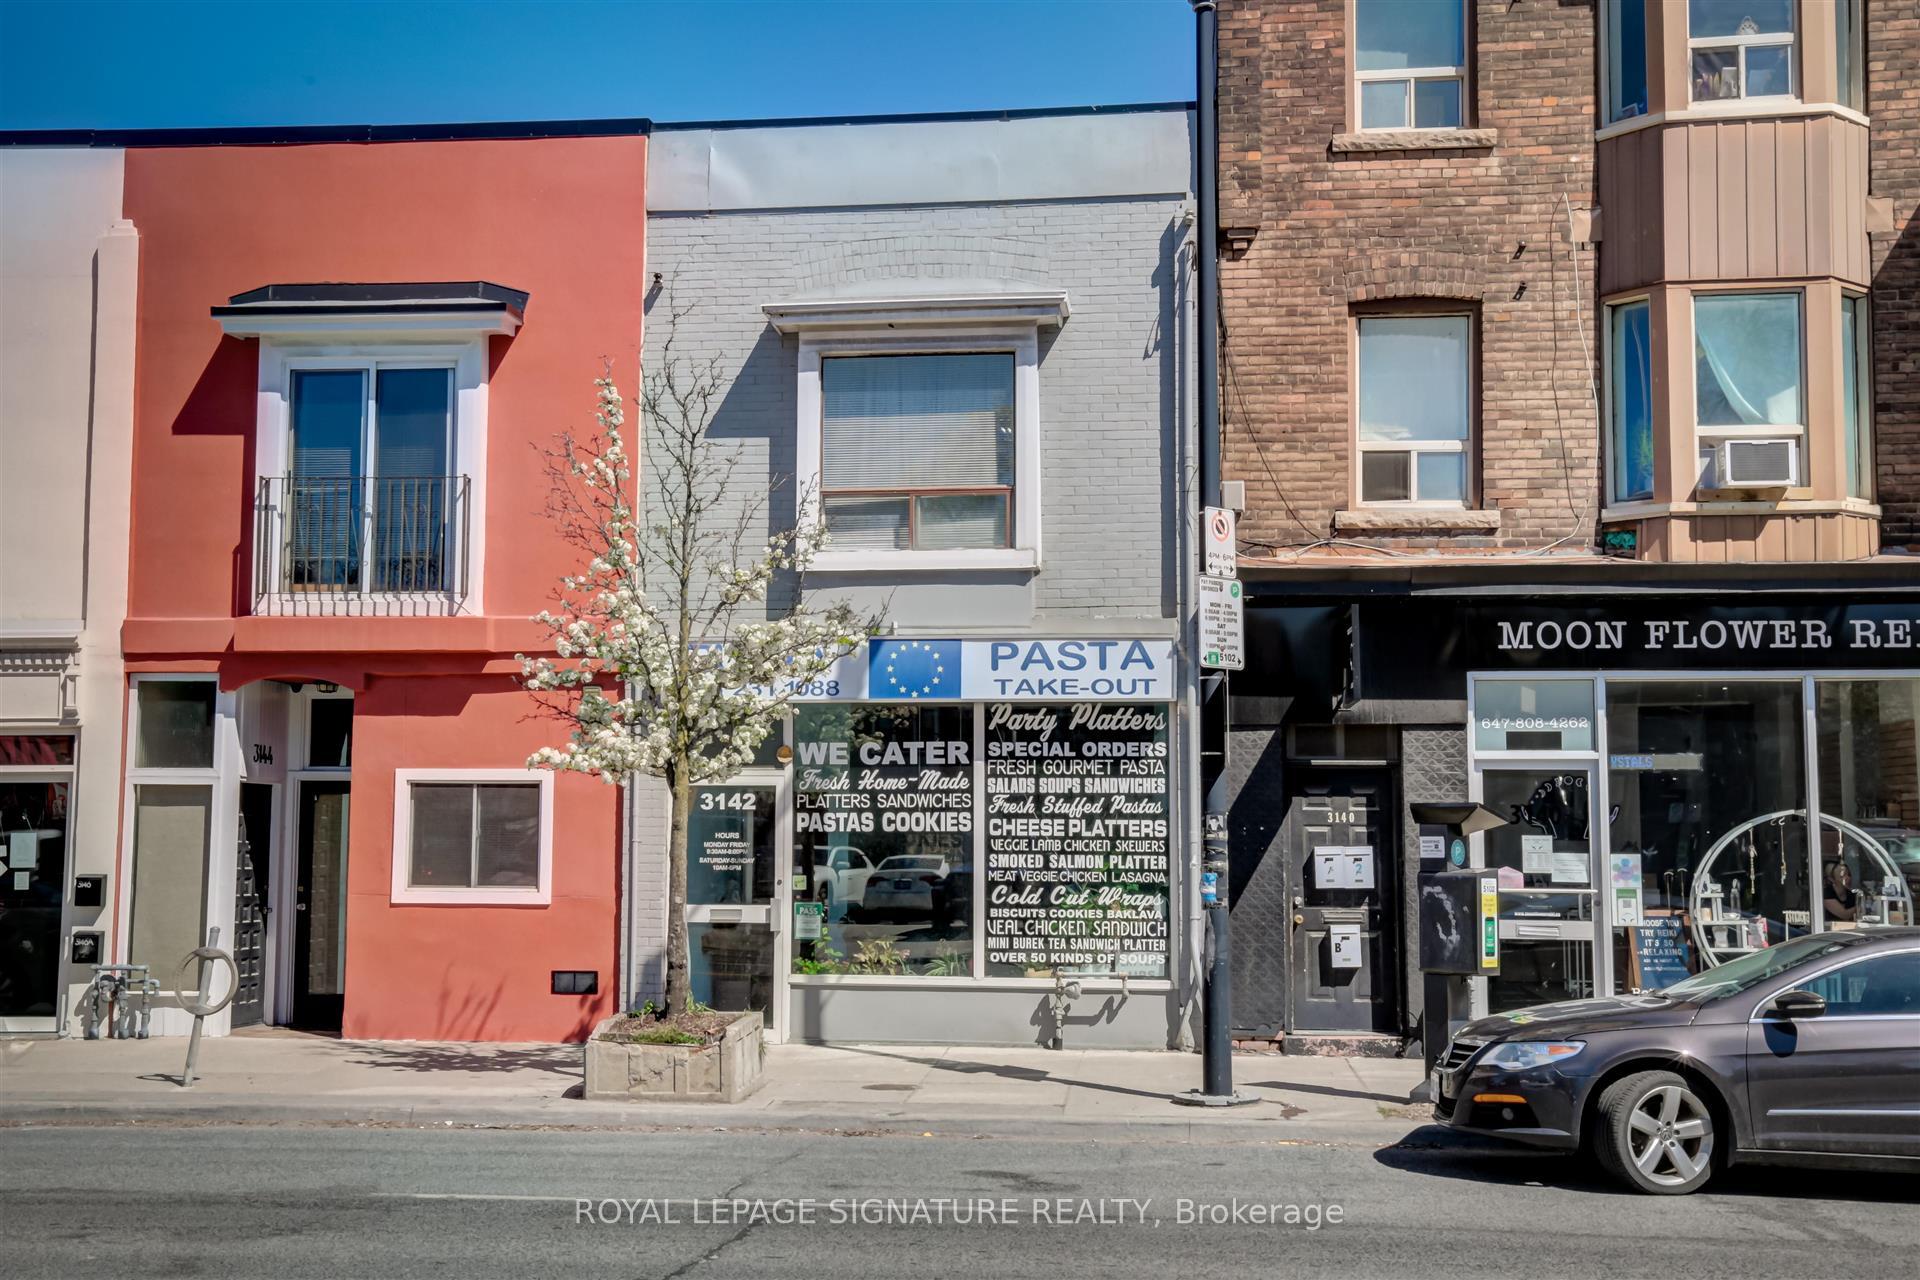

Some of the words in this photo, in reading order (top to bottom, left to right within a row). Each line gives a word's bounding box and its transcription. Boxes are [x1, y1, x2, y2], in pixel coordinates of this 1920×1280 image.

[1497, 621, 1627, 649] MOON
[1644, 620, 1832, 649] FLOWER
[991, 641, 1155, 671] PASTA
[1220, 653, 1236, 662] 5102
[993, 678, 1157, 695] TAKE-OUT
[988, 702, 1057, 742] Party
[1069, 703, 1167, 731] Platters
[1481, 717, 1588, 729] 647-808-4262
[798, 742, 848, 765] WE
[859, 742, 970, 765] CATER
[988, 742, 1076, 757] SPECIAL
[1082, 742, 1167, 757] ORDERS
[988, 760, 1036, 775] FRESH
[1043, 760, 1114, 775] GOURMET
[1120, 760, 1165, 775] PASTA
[799, 770, 850, 790] Fresh
[858, 770, 970, 790] Home-Made
[988, 778, 1035, 794] SALADS
[1039, 778, 1081, 794] SOUPS
[1085, 778, 1166, 794] SANDWICHES
[700, 793, 756, 810] 3142
[797, 794, 870, 808] PLATTERS
[877, 794, 972, 808] SANDWICHES
[988, 795, 1036, 814] Fresh
[1042, 795, 1103, 818] Stuffed
[1110, 795, 1164, 814] Pastas
[797, 812, 874, 832] PASTAS
[882, 812, 972, 832] COOKIES
[1327, 812, 1355, 823] 3140
[989, 819, 1065, 837] CHEESE
[1069, 820, 1167, 837] PLATTERS
[991, 839, 1028, 851] VEGGIE
[1032, 839, 1062, 851] LAMB
[1064, 840, 1110, 852] CHICKEN
[1115, 840, 1165, 852] SKEWERS
[989, 854, 1043, 868] SMOKED
[1049, 854, 1104, 869] SALMON
[1109, 855, 1167, 869] PLATTER
[988, 870, 1017, 882] MEAT
[1019, 870, 1058, 882] VEGGIE
[1059, 871, 1107, 882] CHICKEN
[1112, 872, 1166, 883] LASAGNA
[991, 885, 1044, 904] Cold
[1050, 885, 1090, 905] Cut
[1098, 886, 1164, 910] Wraps
[799, 907, 818, 915] PASS
[990, 908, 1046, 918] BISCUITS
[1049, 909, 1103, 918] COOKIES
[1107, 909, 1163, 919] BAKLAVA
[987, 920, 1022, 935] VEAL
[1025, 920, 1085, 936] CHICKEN
[1093, 921, 1167, 937] SANDWICH
[1640, 929, 1654, 937] TRY
[988, 937, 1009, 949] MINI
[1013, 937, 1044, 949] BUREK
[1048, 938, 1066, 950] TEA
[1070, 938, 1120, 950] SANDWICH
[1124, 938, 1165, 951] PLATTER
[1334, 943, 1342, 953] B
[990, 952, 1027, 962] OVER
[1031, 952, 1046, 963] 50
[1050, 953, 1092, 963] KINDS
[1097, 953, 1115, 964] OF
[1119, 953, 1165, 964] SOUPS
